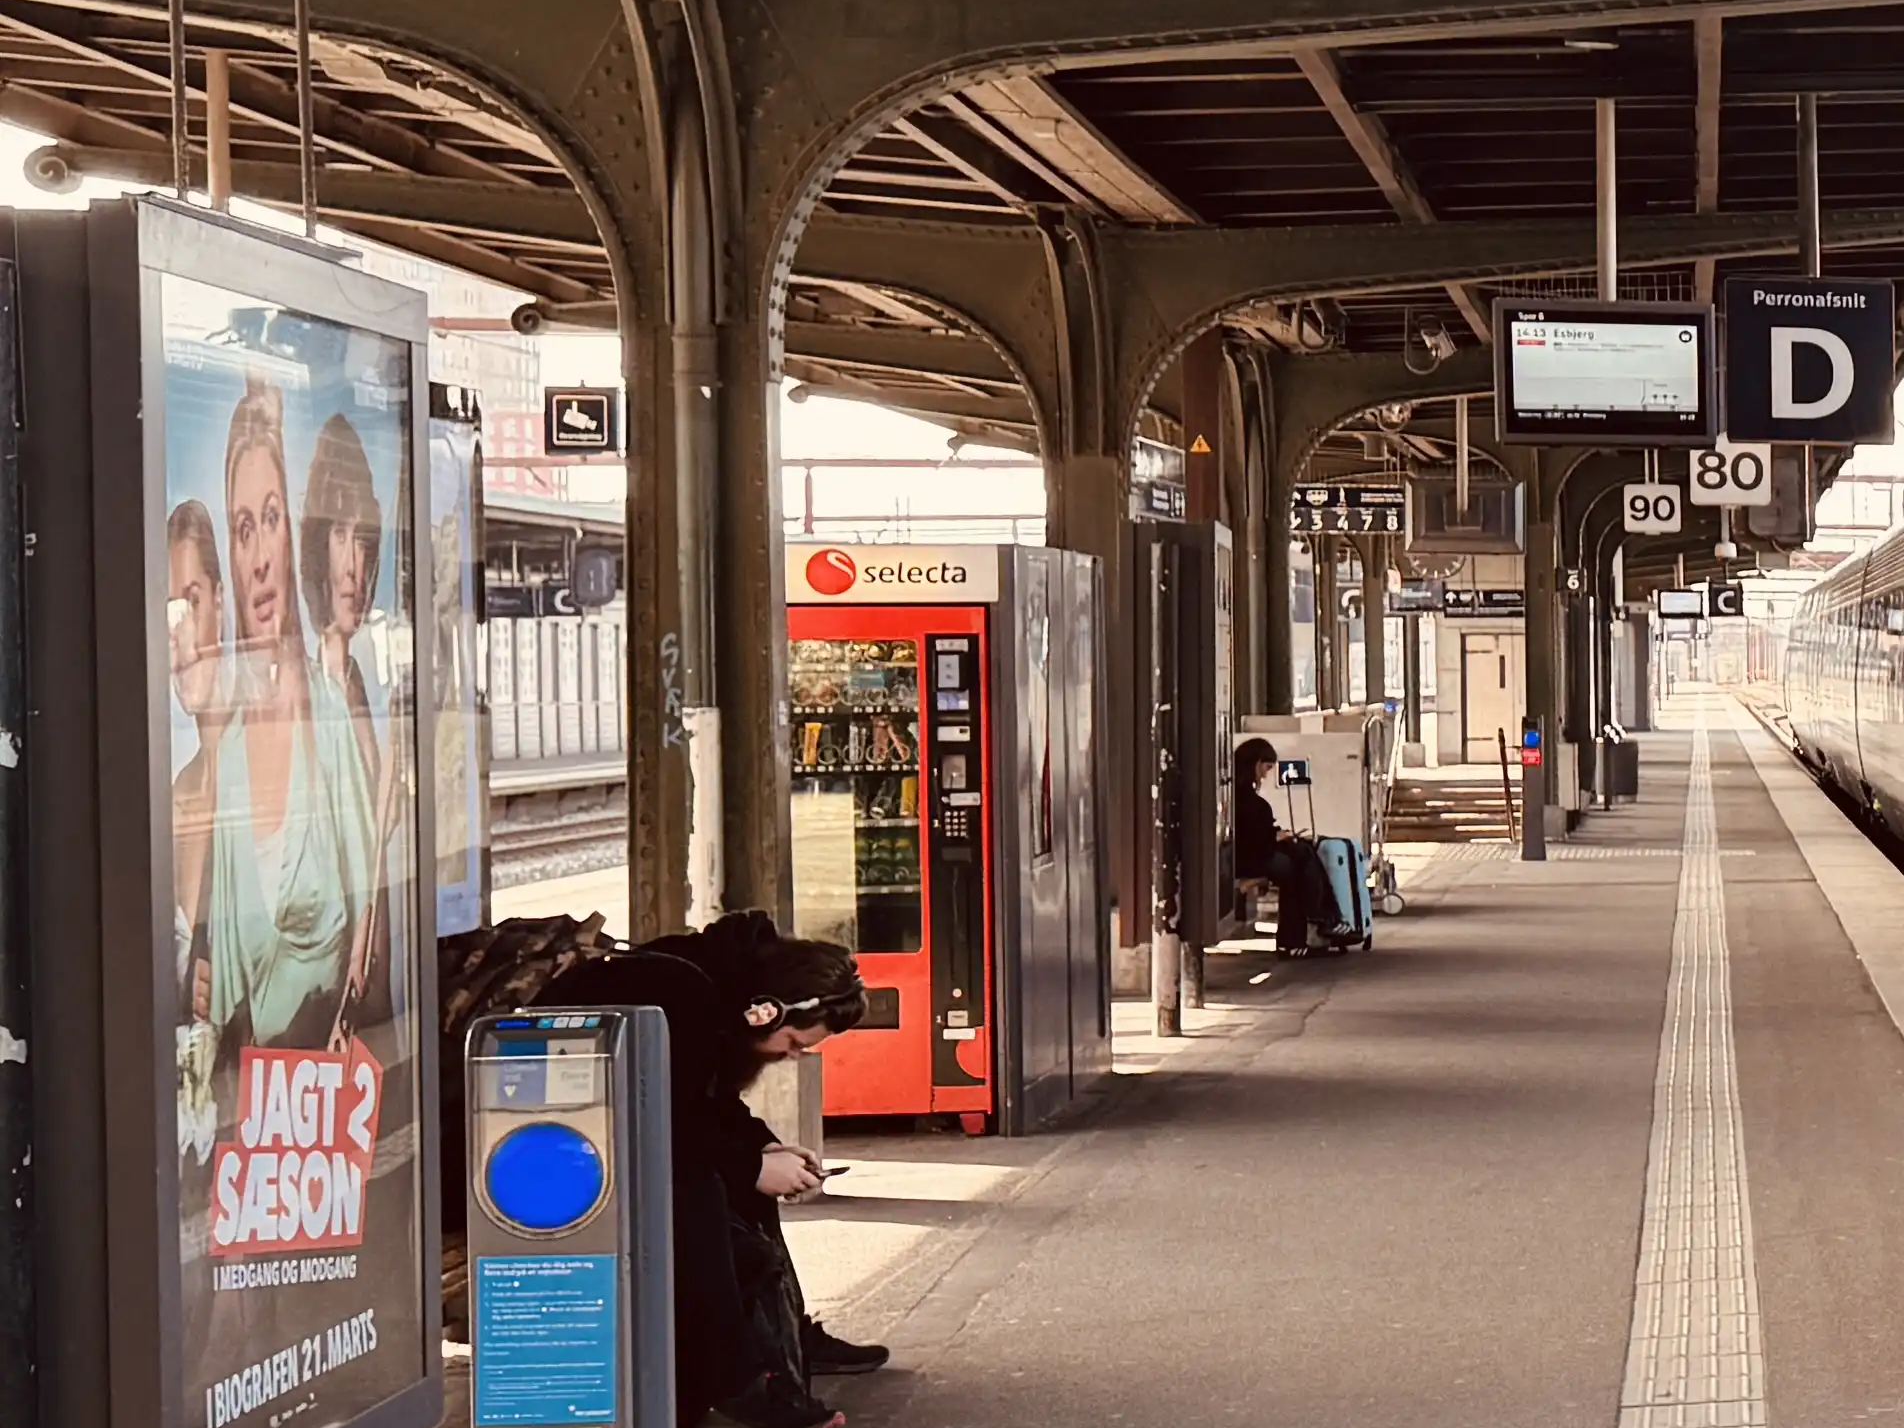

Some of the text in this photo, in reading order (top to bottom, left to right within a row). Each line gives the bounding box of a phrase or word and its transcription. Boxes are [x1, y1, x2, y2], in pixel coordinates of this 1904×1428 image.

[1770, 326, 1855, 419] D
[1696, 451, 1764, 490] 80
[1629, 494, 1676, 522] 90
[863, 561, 967, 584] selecta
[241, 1058, 376, 1153] JAGT 2
[213, 1150, 363, 1246] SÆSON
[219, 1262, 280, 1290] MEDGANG
[281, 1260, 298, 1284] OG
[300, 1255, 358, 1283] MODGANG
[214, 1345, 300, 1428] BIOGRAFEN
